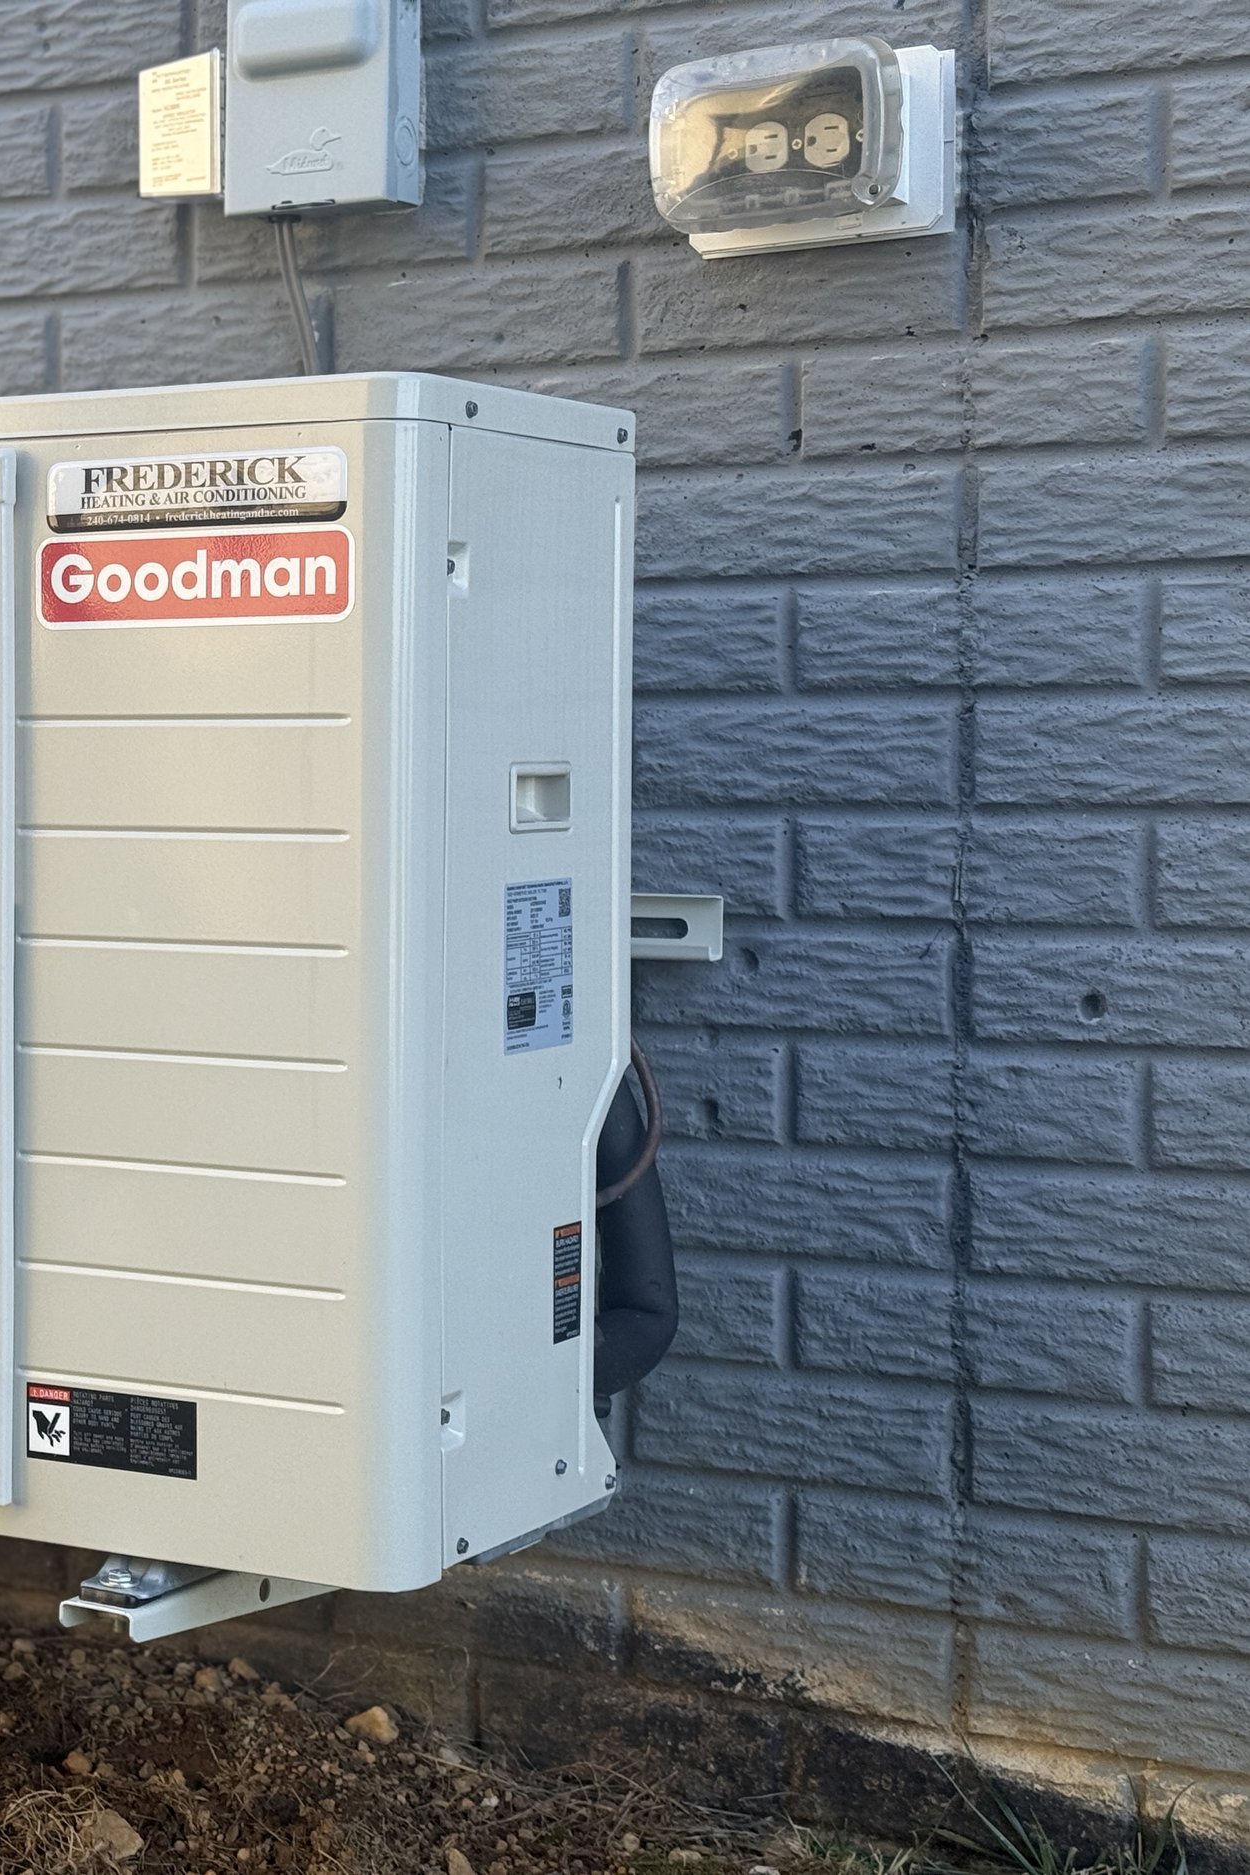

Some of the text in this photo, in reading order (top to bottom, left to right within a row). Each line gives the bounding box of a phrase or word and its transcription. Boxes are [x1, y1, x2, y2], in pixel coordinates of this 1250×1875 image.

[81, 456, 307, 495] FREDERICK
[81, 486, 307, 510] HEATING & AIR CONDITIONING
[165, 507, 299, 523] frederickheatingandac.com
[51, 549, 337, 604] Goodman
[39, 1389, 69, 1401] DANGER
